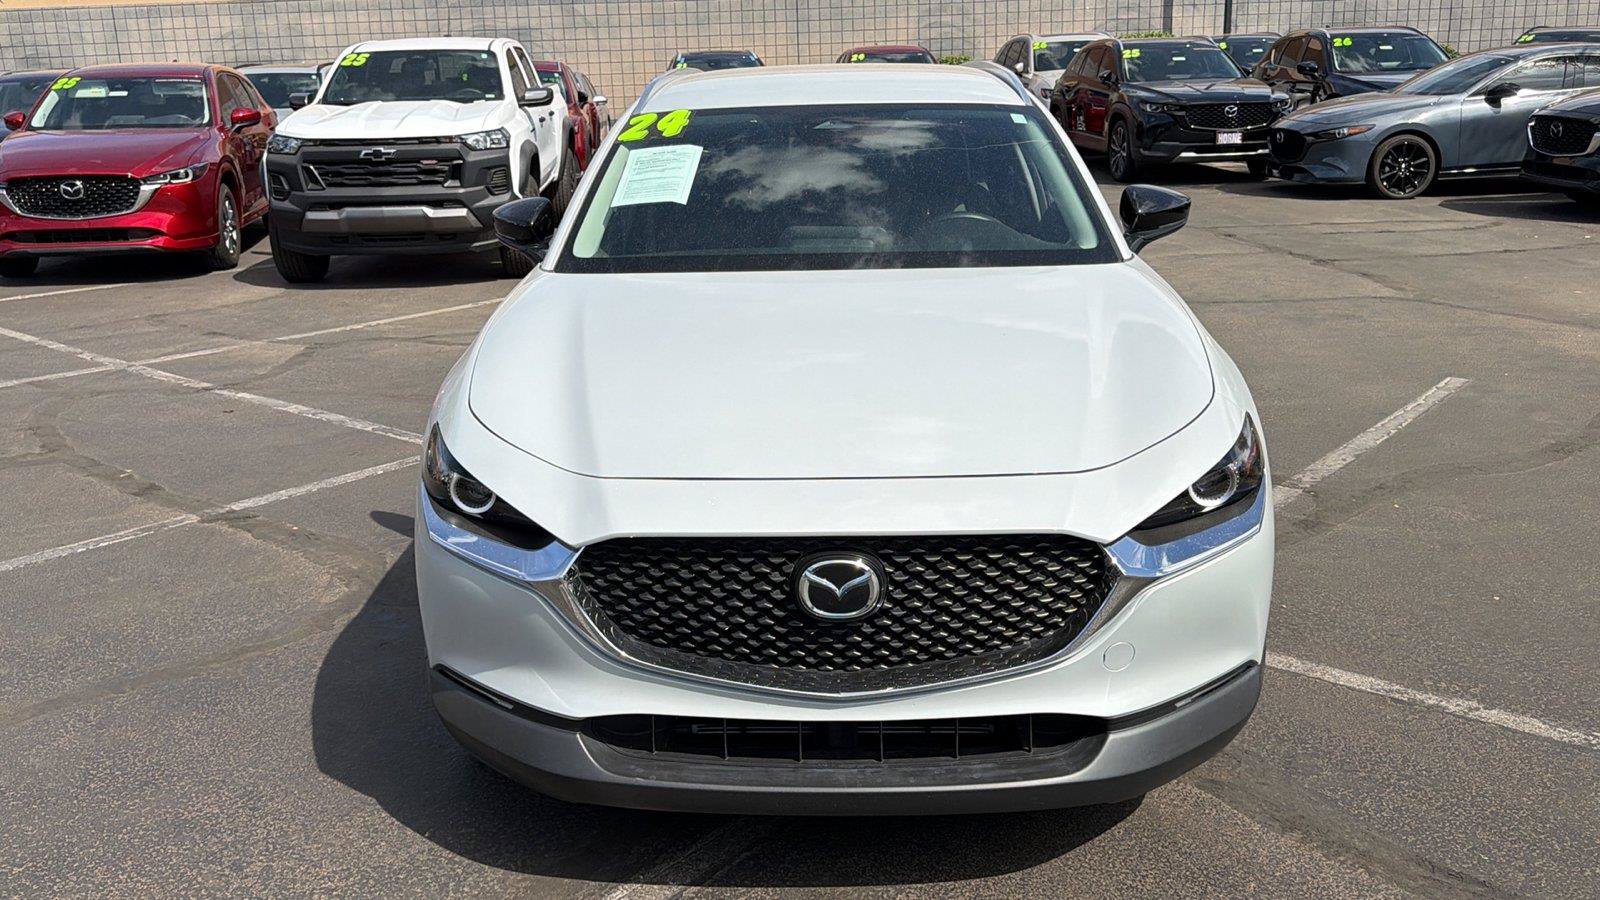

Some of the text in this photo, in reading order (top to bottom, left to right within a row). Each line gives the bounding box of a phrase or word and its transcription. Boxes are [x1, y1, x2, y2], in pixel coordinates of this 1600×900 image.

[1333, 37, 1353, 47] 26
[340, 53, 371, 67] 25
[1122, 48, 1141, 59] 25
[51, 77, 82, 92] 25
[617, 109, 693, 142] 24
